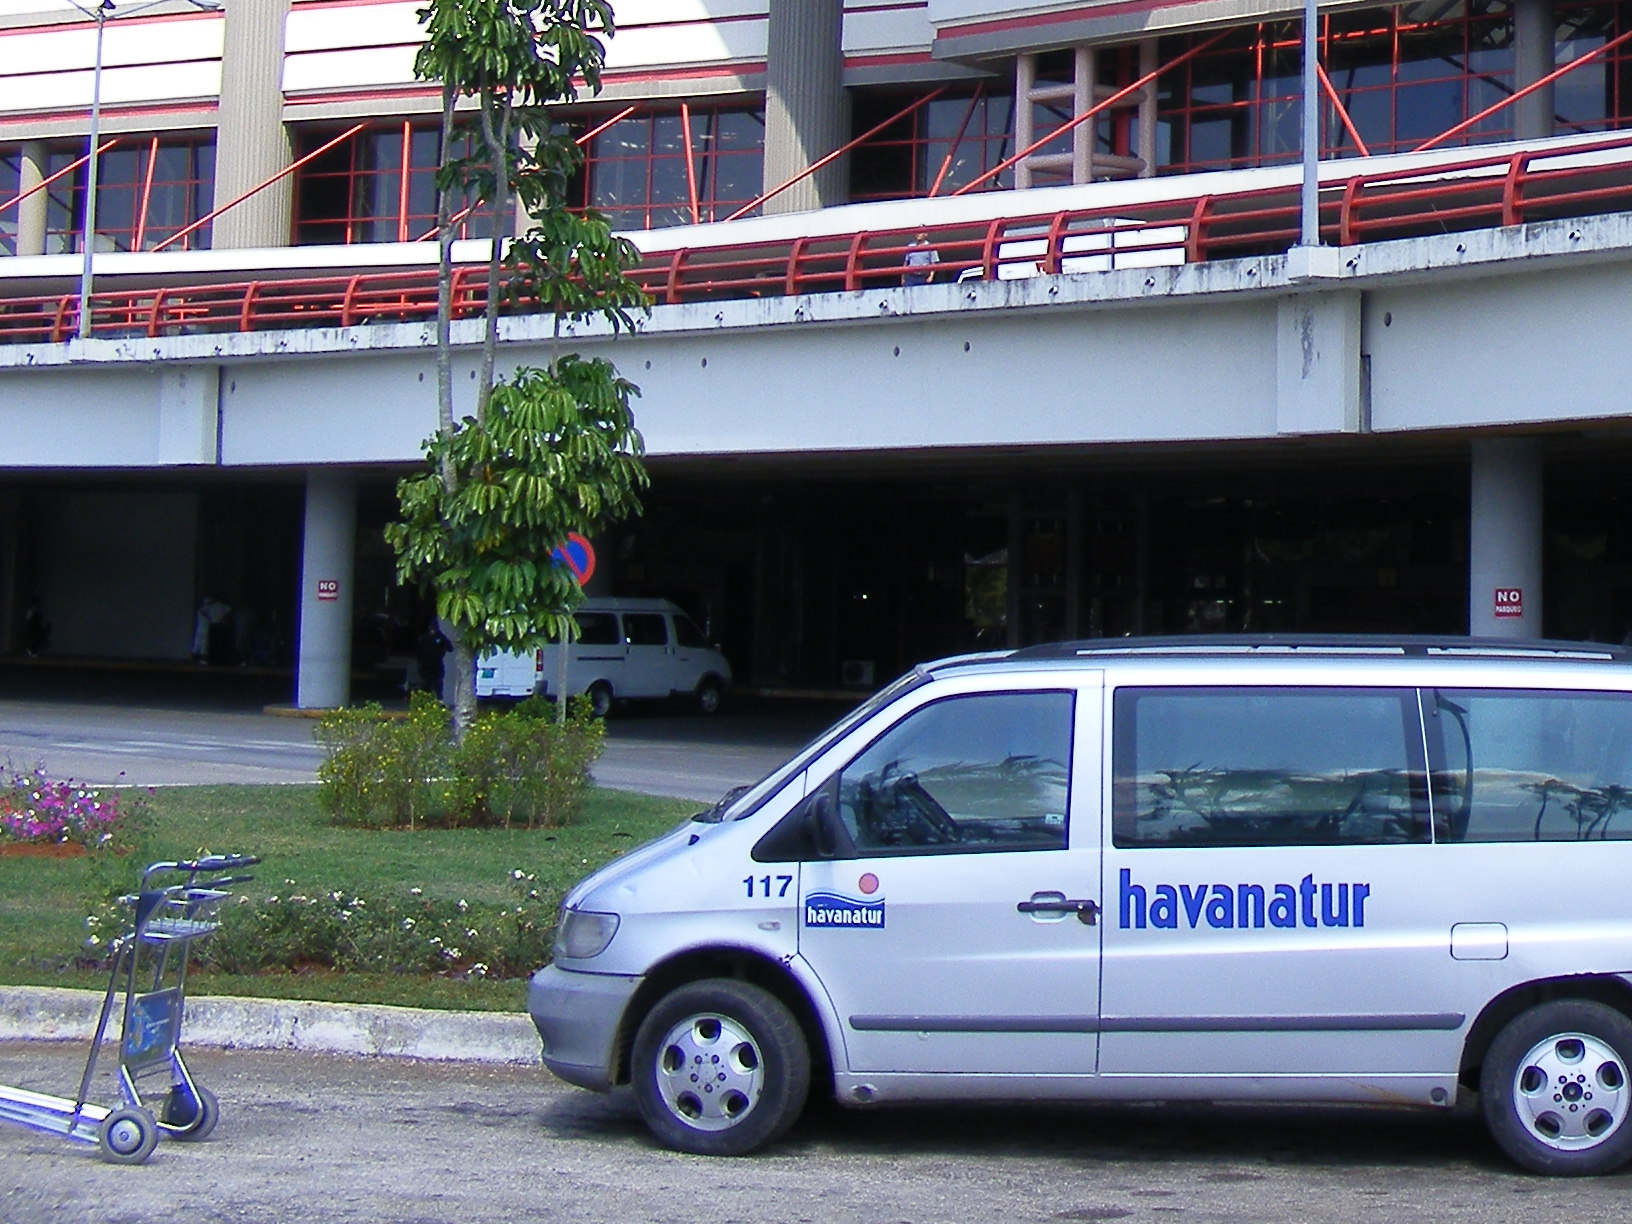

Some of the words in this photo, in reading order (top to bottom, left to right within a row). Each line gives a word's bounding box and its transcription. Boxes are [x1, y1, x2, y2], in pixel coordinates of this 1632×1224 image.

[320, 582, 336, 591] NO
[1497, 591, 1520, 602] NO
[743, 875, 793, 898] 117
[1119, 868, 1371, 929] havanatur
[807, 905, 883, 925] havanatur
